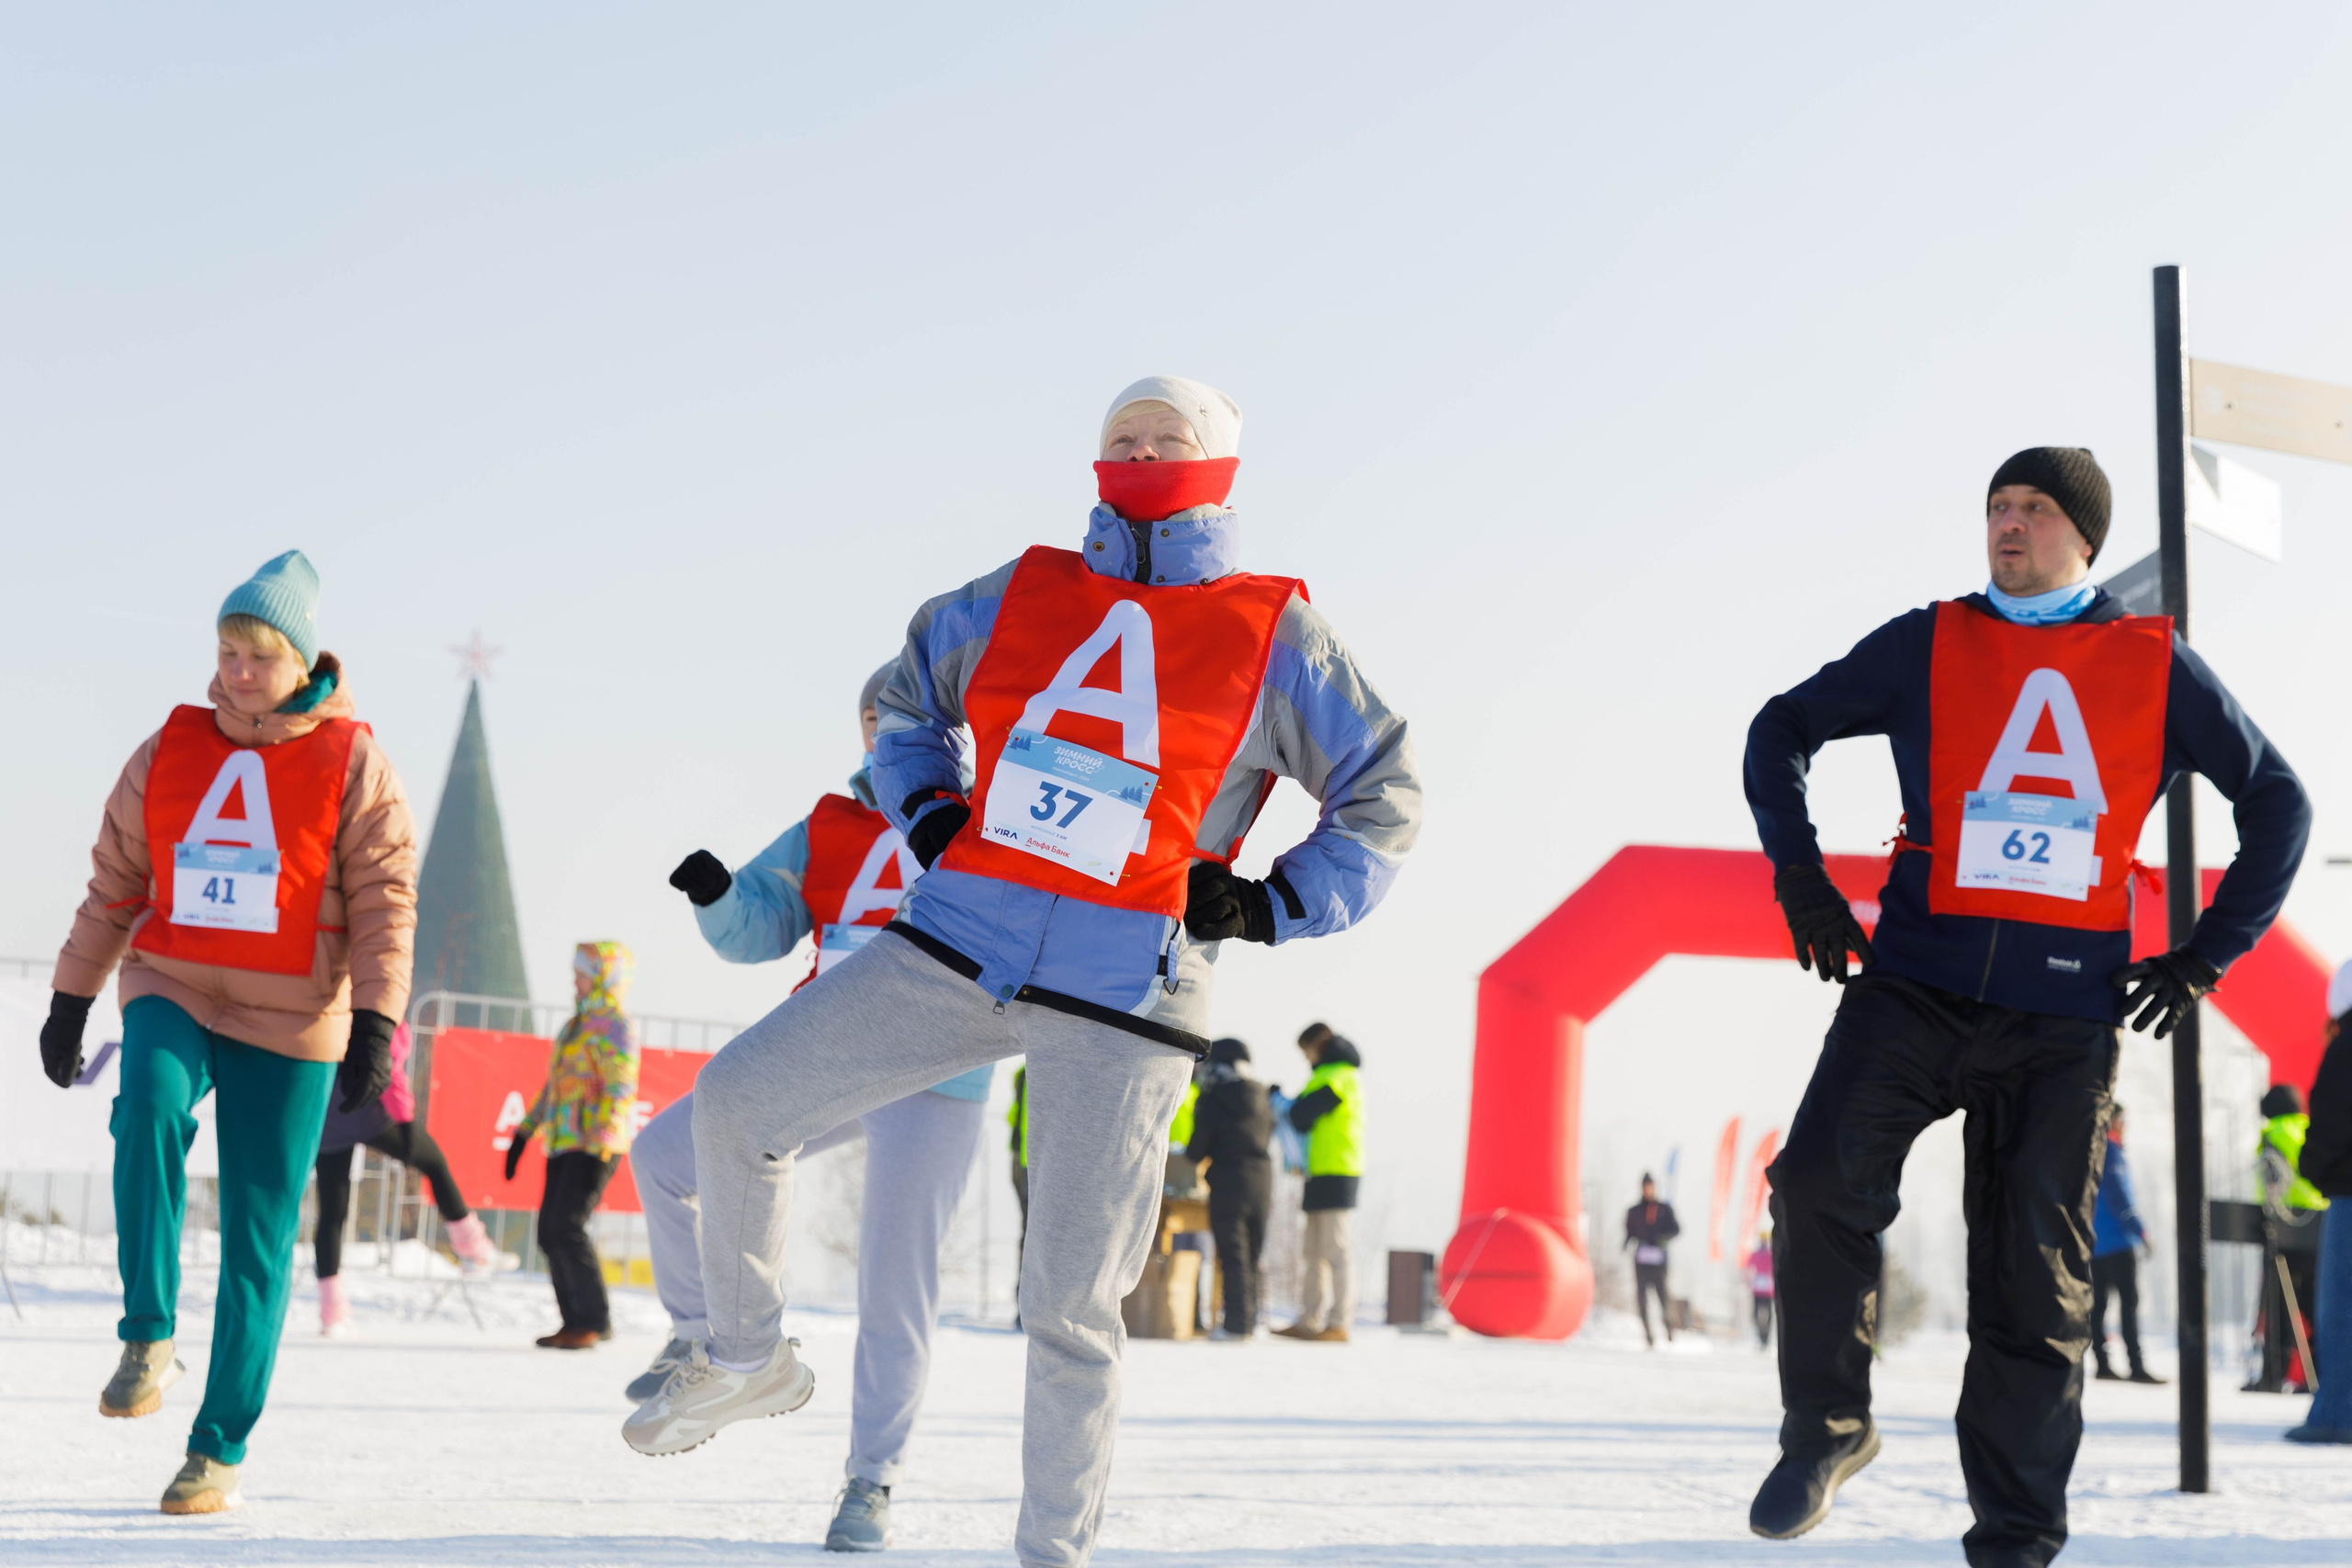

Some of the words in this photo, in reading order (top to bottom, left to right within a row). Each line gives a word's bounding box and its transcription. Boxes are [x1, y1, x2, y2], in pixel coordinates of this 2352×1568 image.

[1054, 747, 1103, 768] ЗИМНИЙ
[1056, 756, 1095, 774] КРОСС
[1030, 781, 1093, 829] 37
[993, 826, 1018, 840] VIRA
[1025, 837, 1050, 851] Альфа
[1050, 845, 1070, 859] Банк
[2002, 829, 2051, 864] 62
[202, 877, 235, 904] 41
